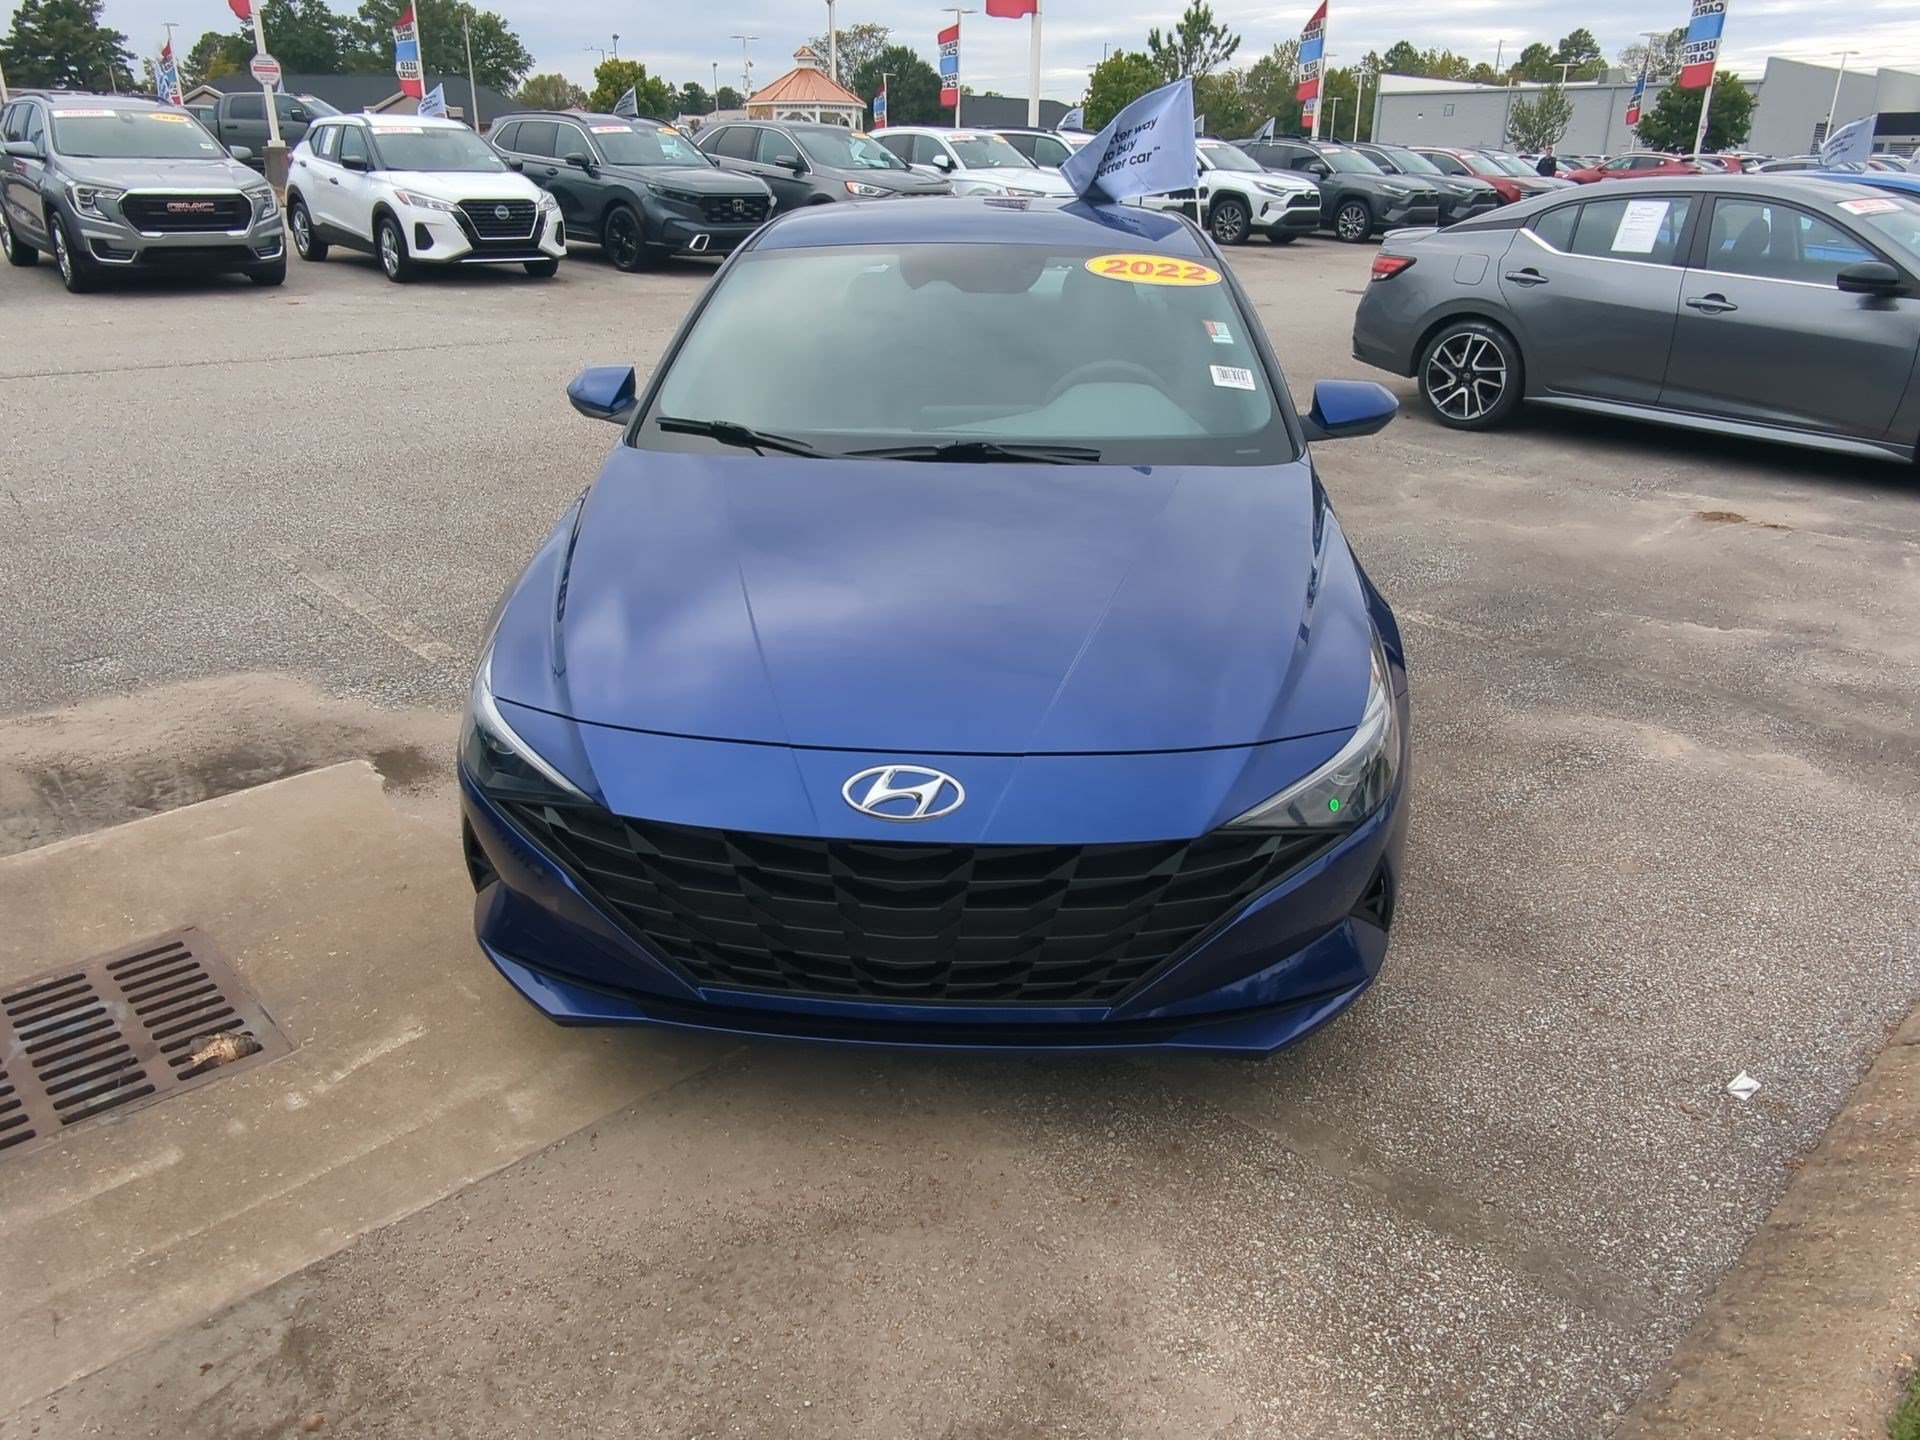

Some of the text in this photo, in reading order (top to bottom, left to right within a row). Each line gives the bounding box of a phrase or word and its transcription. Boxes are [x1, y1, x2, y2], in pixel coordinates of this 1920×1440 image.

[1133, 116, 1159, 134] way
[1116, 138, 1138, 156] buy
[1102, 259, 1207, 281] 2022
